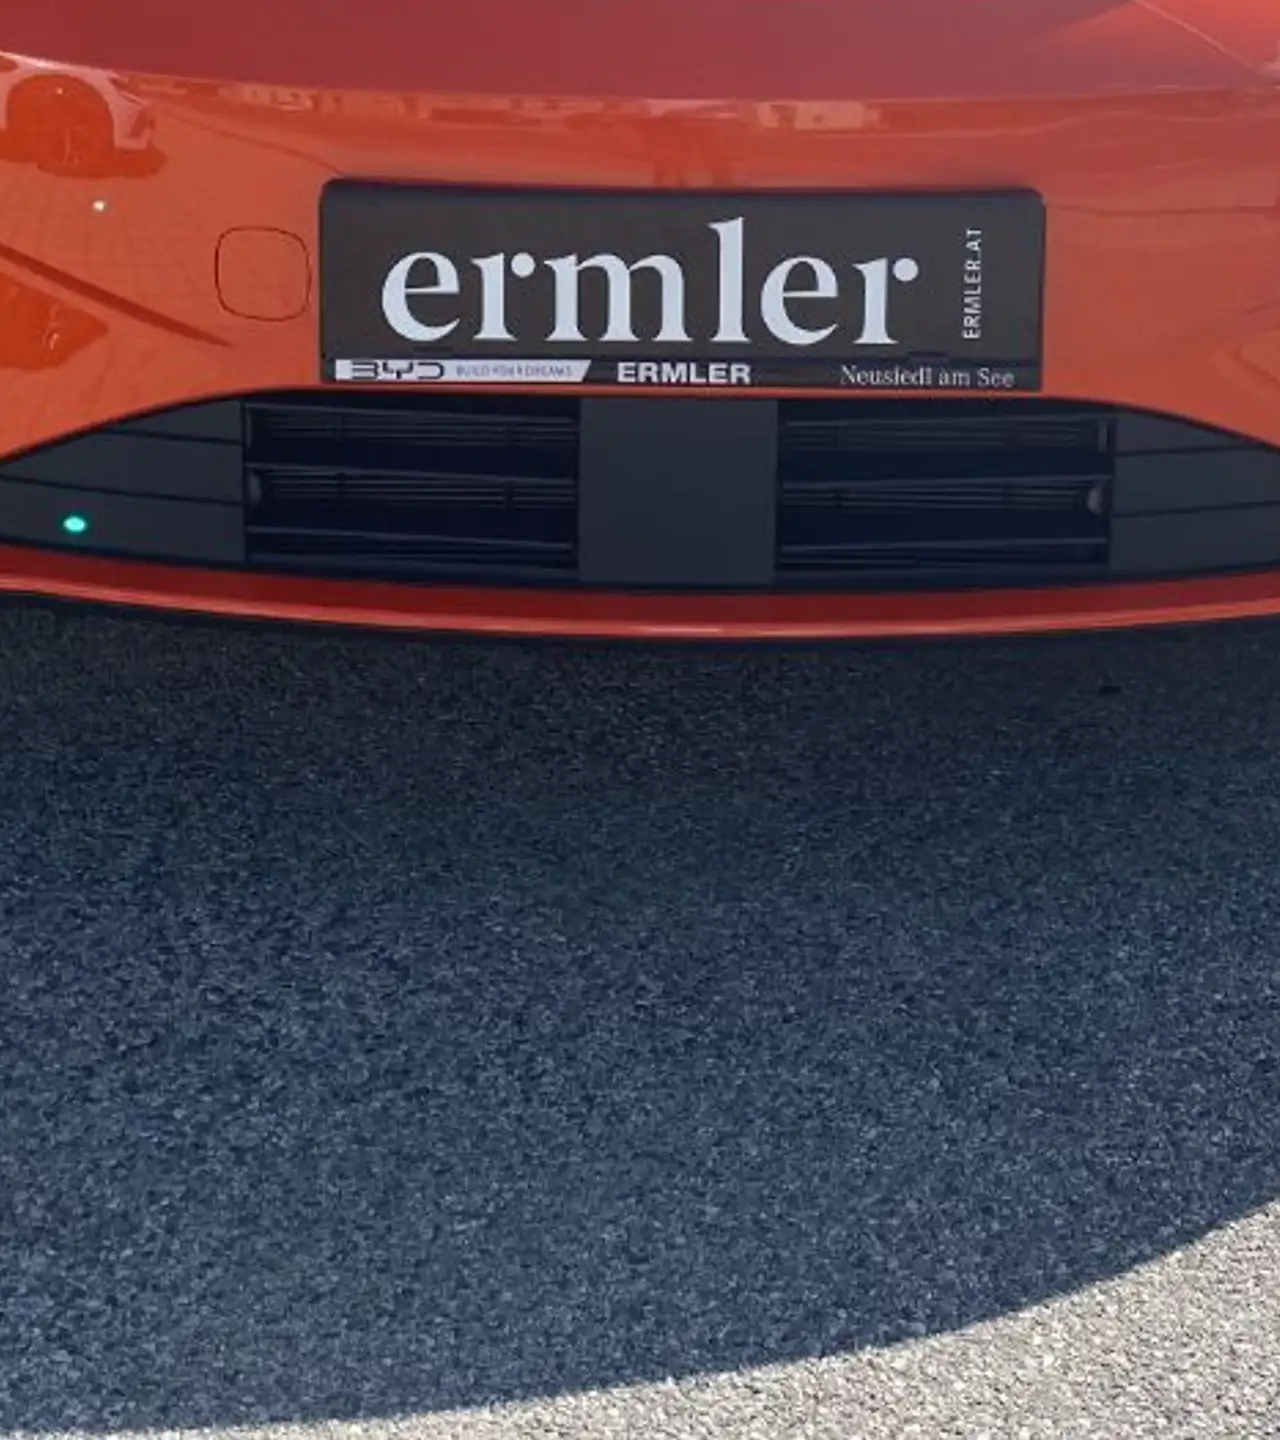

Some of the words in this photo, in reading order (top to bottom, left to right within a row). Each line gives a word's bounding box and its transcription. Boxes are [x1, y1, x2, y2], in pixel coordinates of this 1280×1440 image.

[380, 216, 920, 346] ermler
[961, 226, 984, 341] ERMLER.AT
[352, 361, 444, 380] BYD
[616, 362, 752, 386] ERMLER
[839, 363, 933, 388] Neusiedl
[940, 368, 972, 388] am
[977, 365, 1015, 389] See
